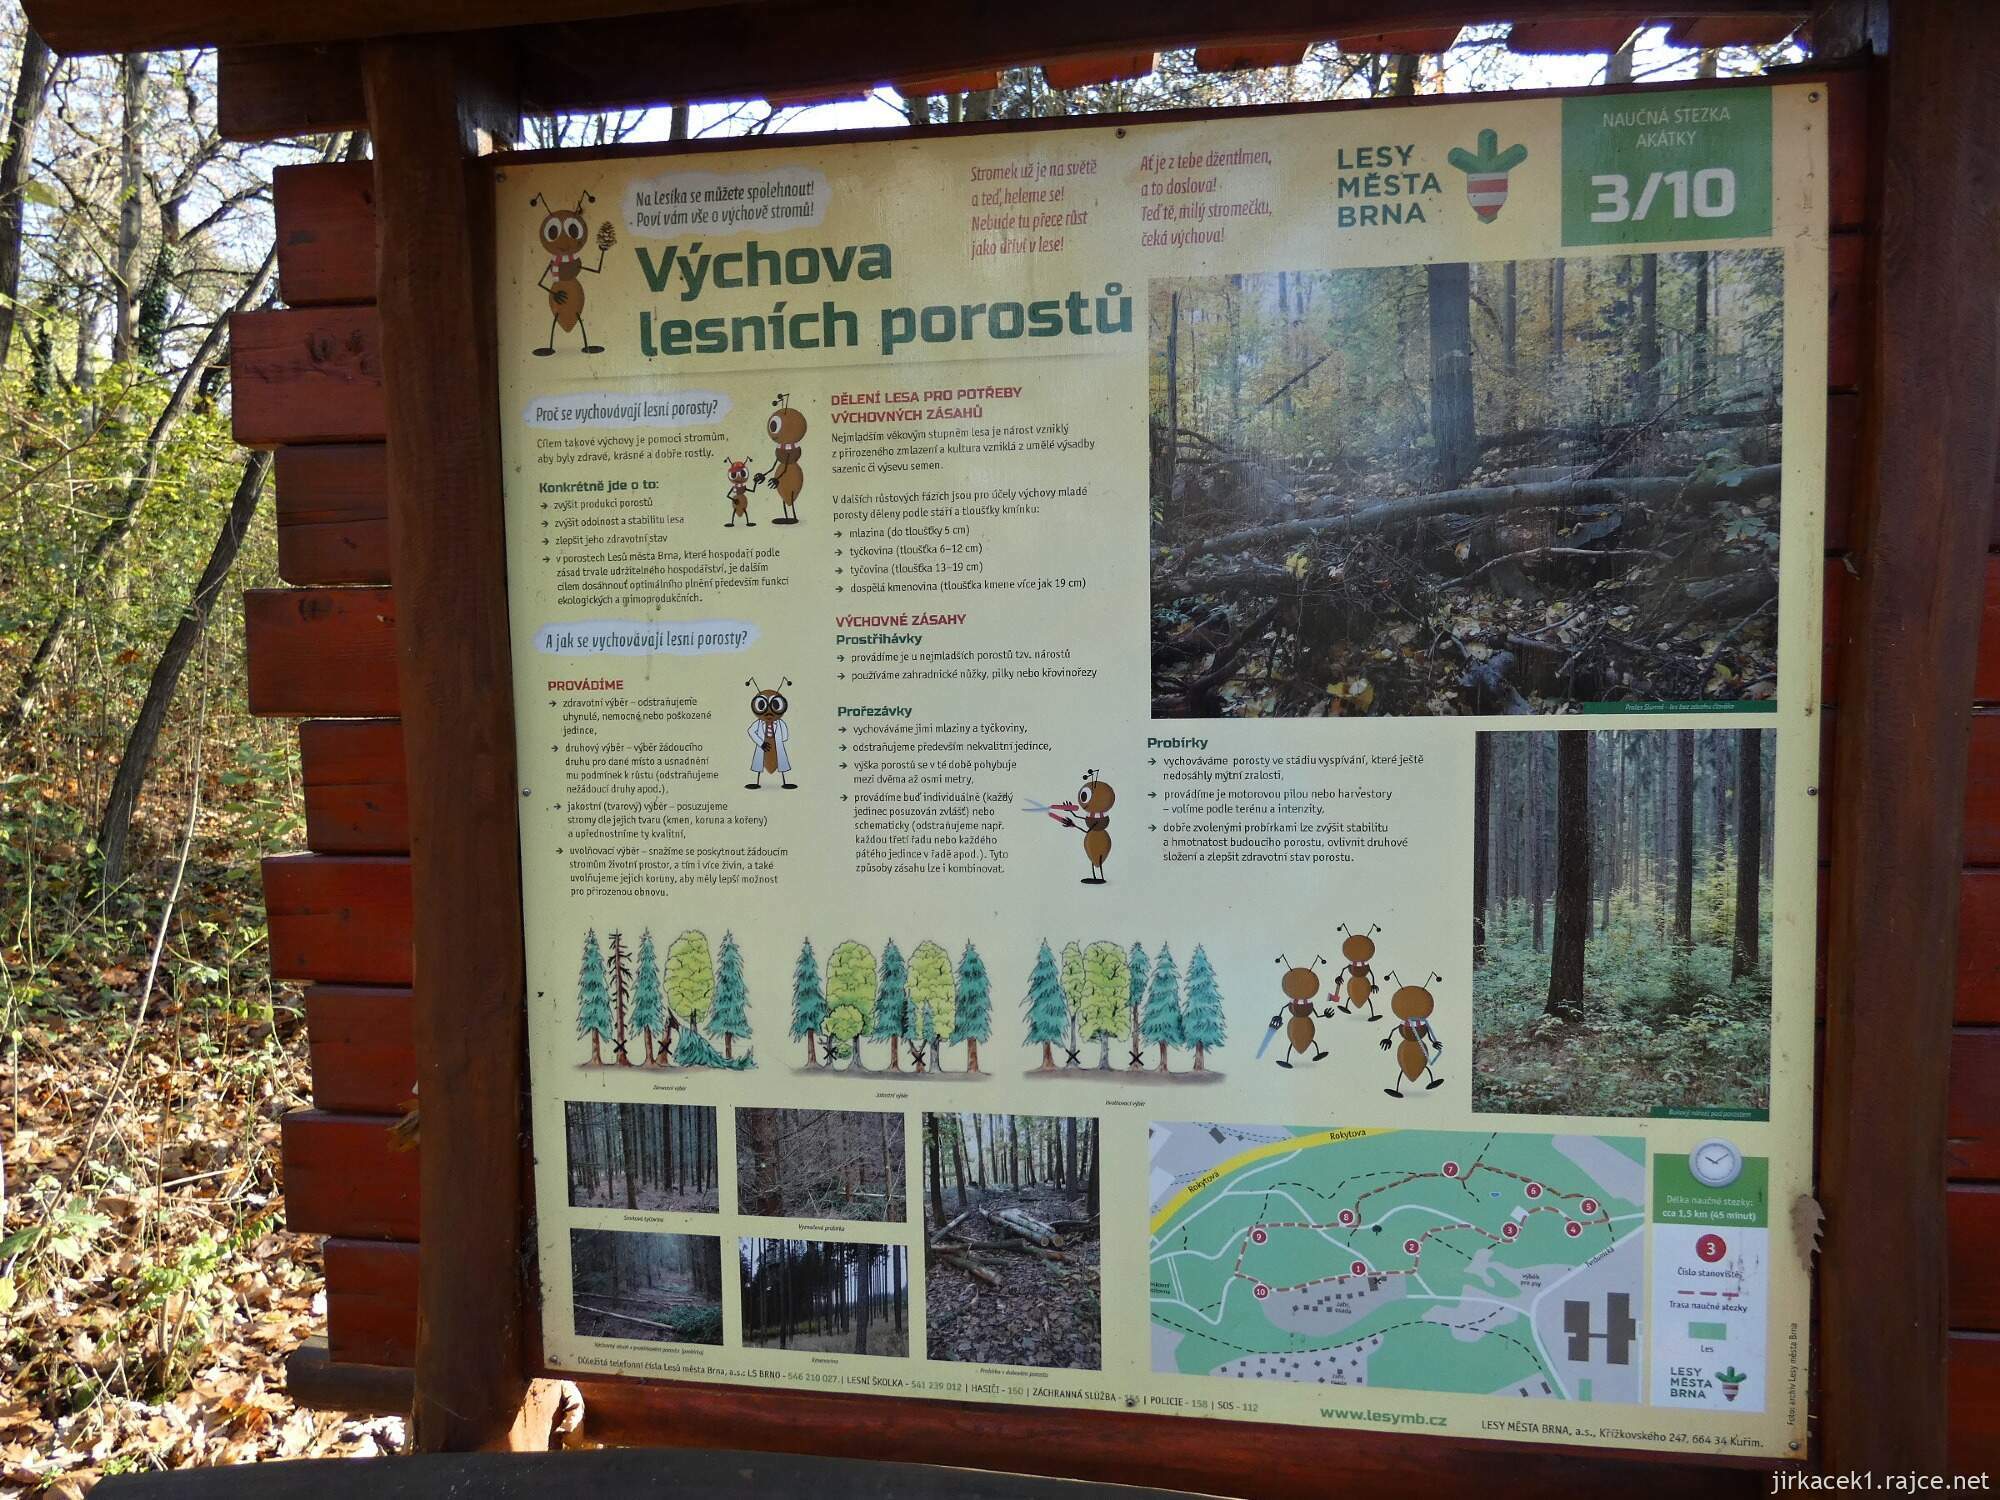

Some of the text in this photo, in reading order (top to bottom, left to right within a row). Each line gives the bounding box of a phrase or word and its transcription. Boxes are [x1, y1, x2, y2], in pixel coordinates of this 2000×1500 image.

[1603, 107, 1731, 128] NAUČNÁ STEZKA
[1636, 129, 1696, 148] AKÁTKY
[1140, 149, 1272, 174] Ať je z tebe džentlmen,
[1337, 144, 1415, 170] LESY
[971, 159, 1096, 182] Stromek už je na světě
[636, 181, 814, 206] Na Lesíka se můžete spolehnout!
[1142, 176, 1216, 196] a to doslova!
[1337, 170, 1442, 198] MĚSTA
[972, 185, 1064, 207] a teď, heleme se!
[1591, 168, 1736, 223] 3/10
[637, 202, 814, 226] Poví vám vše o výchově stromů!
[1141, 199, 1272, 222] Teď tě, milý stromečku,
[1337, 203, 1426, 228] BRNA
[972, 209, 1088, 232] Nebude tu přece růst
[1142, 226, 1224, 249] čeká výchova!
[971, 236, 1064, 260] jako dříví v lese!
[635, 241, 892, 301] Výchova
[640, 282, 1133, 358] lesních porostů
[831, 386, 1022, 405] DĚLENÍ LESA PRO POTŘEBY
[536, 399, 718, 425] Proč se vychovávají lesní porosty?
[832, 405, 983, 423] VÝCHOVNÝCH ZÁSAHŮ
[539, 478, 660, 493] Konkrétně jde o to:
[554, 497, 653, 512] zvýšit produkci porostů
[850, 525, 970, 539] mlazina (do tloušťky 5 cm)
[850, 546, 893, 558] tyčkovina
[896, 544, 936, 557] (tloušťka
[966, 543, 982, 555] cm)
[836, 613, 966, 627] VÝCHOVNÉ ZÁSAHY
[546, 630, 748, 653] A jak se vychovávají lesní porosty?
[836, 633, 922, 646] Prostřihávky
[548, 677, 624, 691] PROVÁDÍME
[852, 670, 900, 682] používáme
[902, 669, 958, 679] zahradnické
[960, 669, 989, 681] nůžky,
[1016, 668, 1040, 677] nebo
[1042, 667, 1097, 679] křovinořezy
[838, 705, 912, 718] Prořezávky
[1148, 737, 1208, 750] Probírky
[1164, 755, 1228, 768] vychováváme
[1233, 755, 1271, 768] porosty
[1286, 755, 1316, 764] stádiu
[1319, 755, 1368, 767] vyspívání,
[1371, 754, 1397, 764] které
[1398, 754, 1424, 767] ještě
[1330, 1128, 1366, 1141] Rokytova
[1187, 1171, 1220, 1194] Rokytova
[1694, 1210, 1708, 1218] km
[1711, 1211, 1724, 1220] (45
[1727, 1212, 1755, 1222] minut)
[1706, 1242, 1716, 1255] 3
[1678, 1267, 1696, 1276] Číslo
[1256, 1288, 1266, 1296] 10
[1670, 1301, 1747, 1313] Trasa naučné stezky
[1789, 1323, 1797, 1340] Brna
[1671, 1367, 1702, 1376] LESY
[1788, 1365, 1797, 1381] Lesy
[759, 1370, 780, 1379] BRNO
[847, 1375, 870, 1385] LESNÍ
[872, 1377, 903, 1387] ŠKOLKA
[972, 1383, 1000, 1394] HASIČI
[1033, 1386, 1082, 1400] ZÁCHRANNÁ
[1085, 1390, 1116, 1401] SLUŽBA
[1150, 1396, 1183, 1406] POLICIE
[1218, 1401, 1234, 1409] SOS
[1243, 1403, 1258, 1412] 112
[1671, 1376, 1712, 1388] MĚSTA
[1671, 1389, 1706, 1398] BRNA
[1320, 1406, 1447, 1427] www.lesymb.cz
[1481, 1420, 1505, 1431] LESY
[1507, 1420, 1539, 1434] MĚSTA
[1542, 1423, 1572, 1437] BRNA,
[1600, 1427, 1665, 1443] Křížkovského
[1669, 1432, 1689, 1445] 247,
[1692, 1435, 1711, 1445] 664
[1714, 1436, 1727, 1445] 34
[1730, 1435, 1763, 1448] Kuřim.
